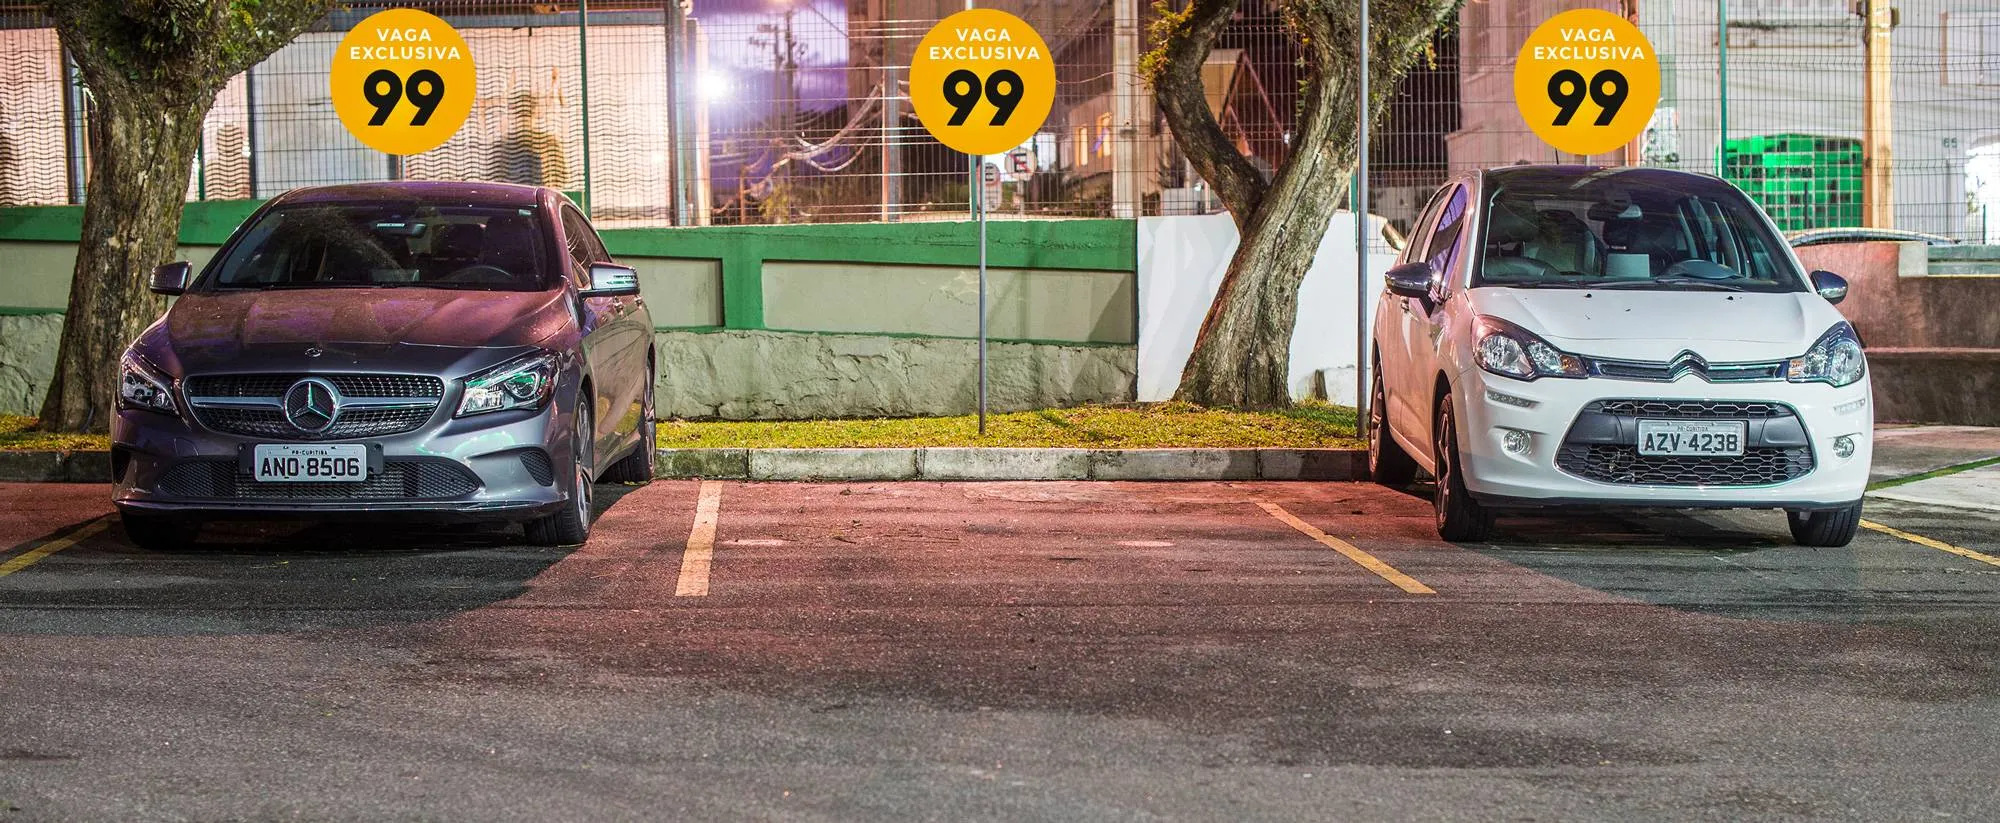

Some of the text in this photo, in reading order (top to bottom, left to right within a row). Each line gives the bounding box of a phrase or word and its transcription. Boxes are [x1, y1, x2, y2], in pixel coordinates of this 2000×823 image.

[376, 28, 432, 42] VAGA
[955, 28, 1011, 42] VAGA
[1560, 28, 1616, 42] VAGA
[350, 46, 461, 60] EXCLUSIVA
[929, 46, 1040, 60] EXCLUSIVA
[1534, 46, 1645, 60] EXCLUSIVA
[363, 69, 445, 126] 99
[942, 69, 1025, 126] 99
[1547, 69, 1629, 126] 99
